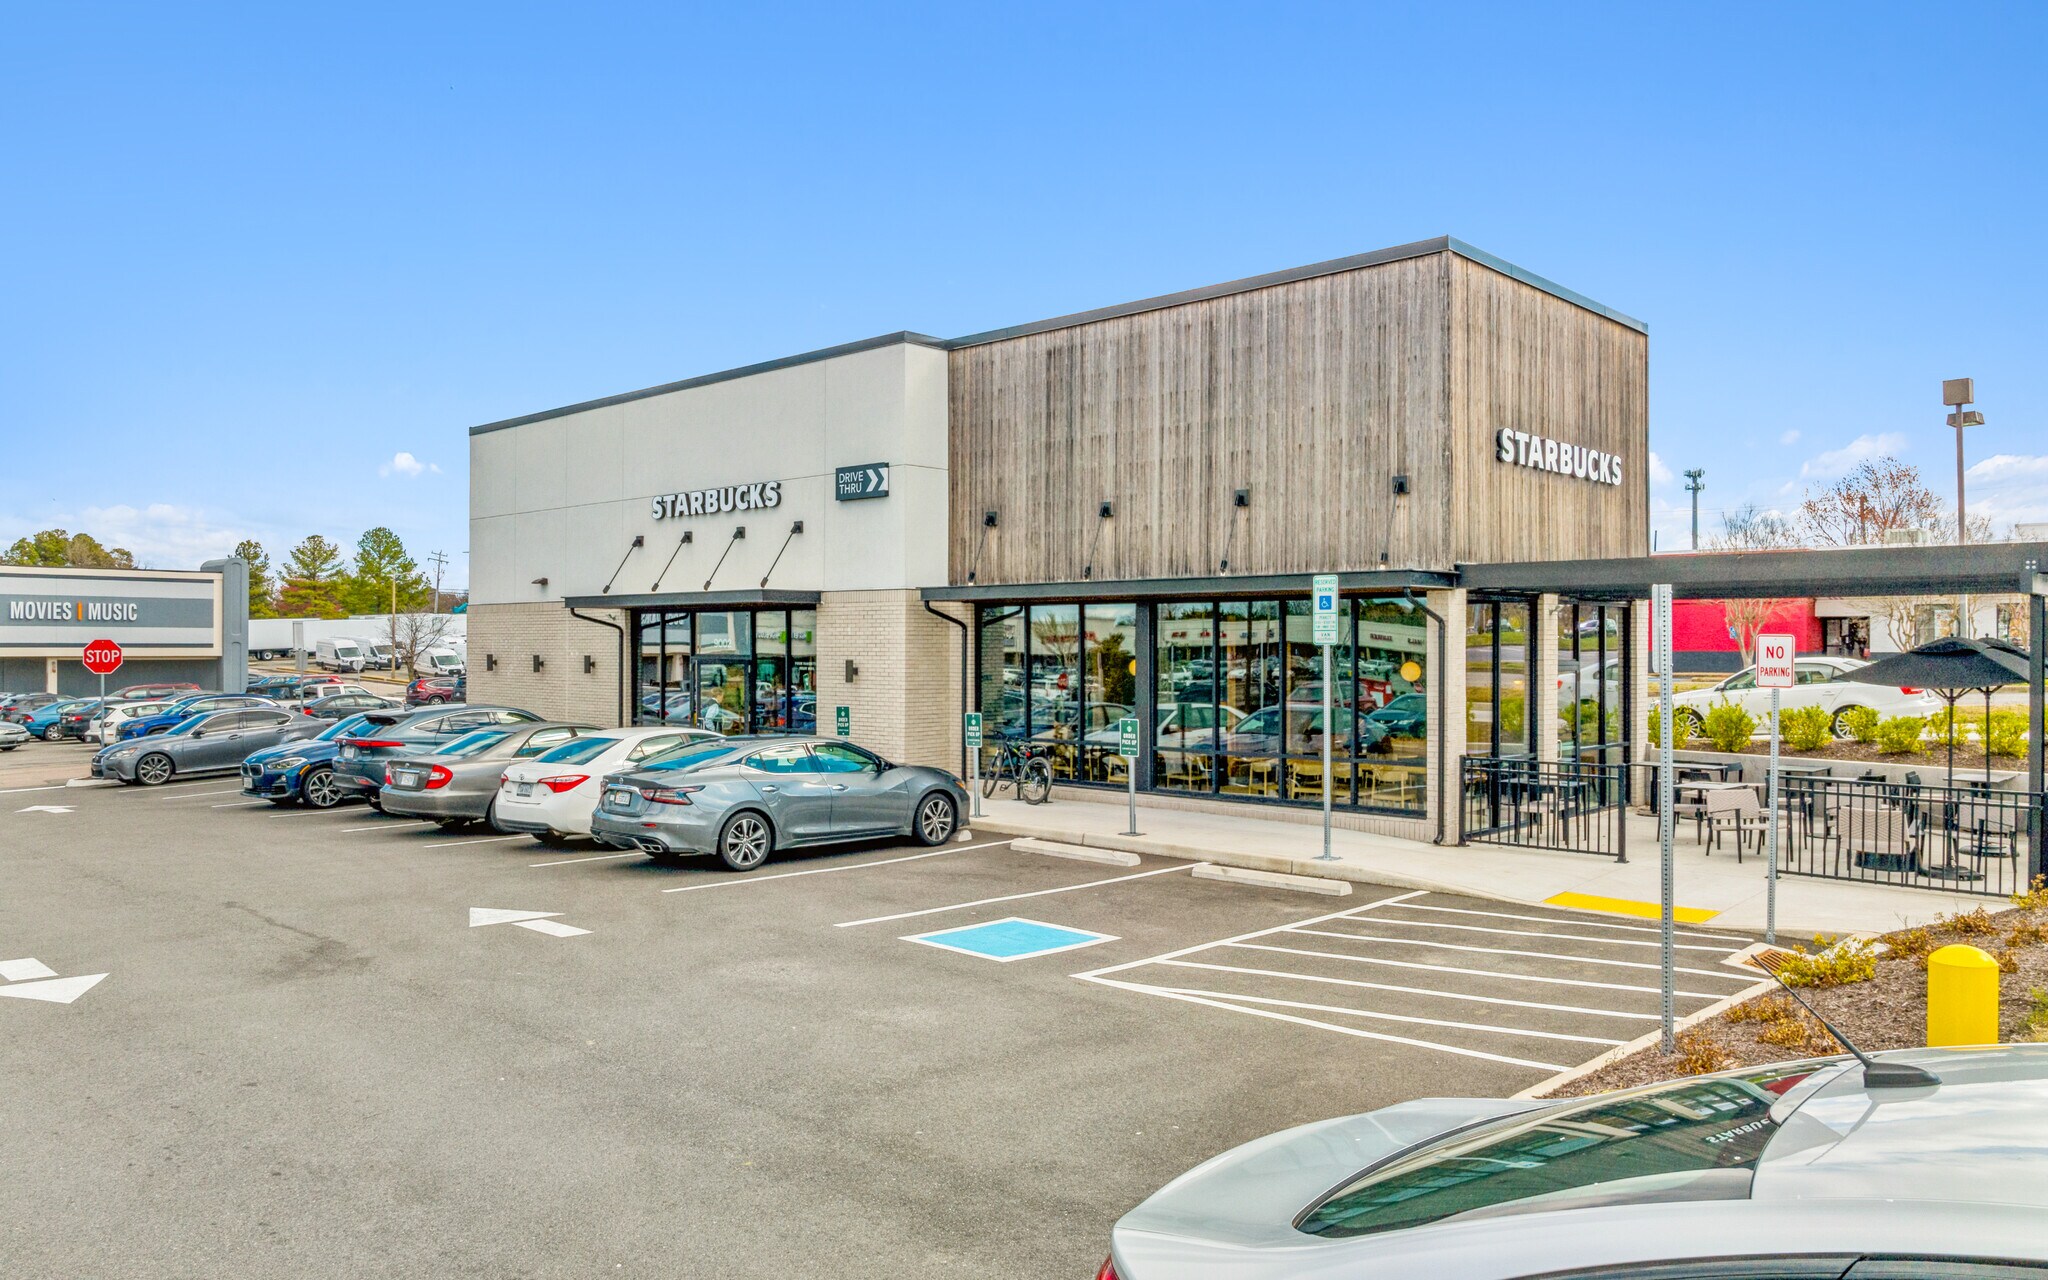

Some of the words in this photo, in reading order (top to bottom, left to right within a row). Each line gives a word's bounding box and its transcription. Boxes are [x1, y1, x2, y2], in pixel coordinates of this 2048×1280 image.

[1498, 427, 1622, 486] STARBUCKS
[839, 471, 864, 484] DRIVE
[839, 482, 862, 494] THRU
[652, 481, 780, 519] STARBUCKS
[10, 601, 72, 620] MOVIES
[88, 602, 138, 620] MUSIC
[713, 638, 732, 648] 9002
[86, 649, 120, 663] STOP
[1766, 645, 1784, 659] NO
[1760, 666, 1790, 677] PARKING
